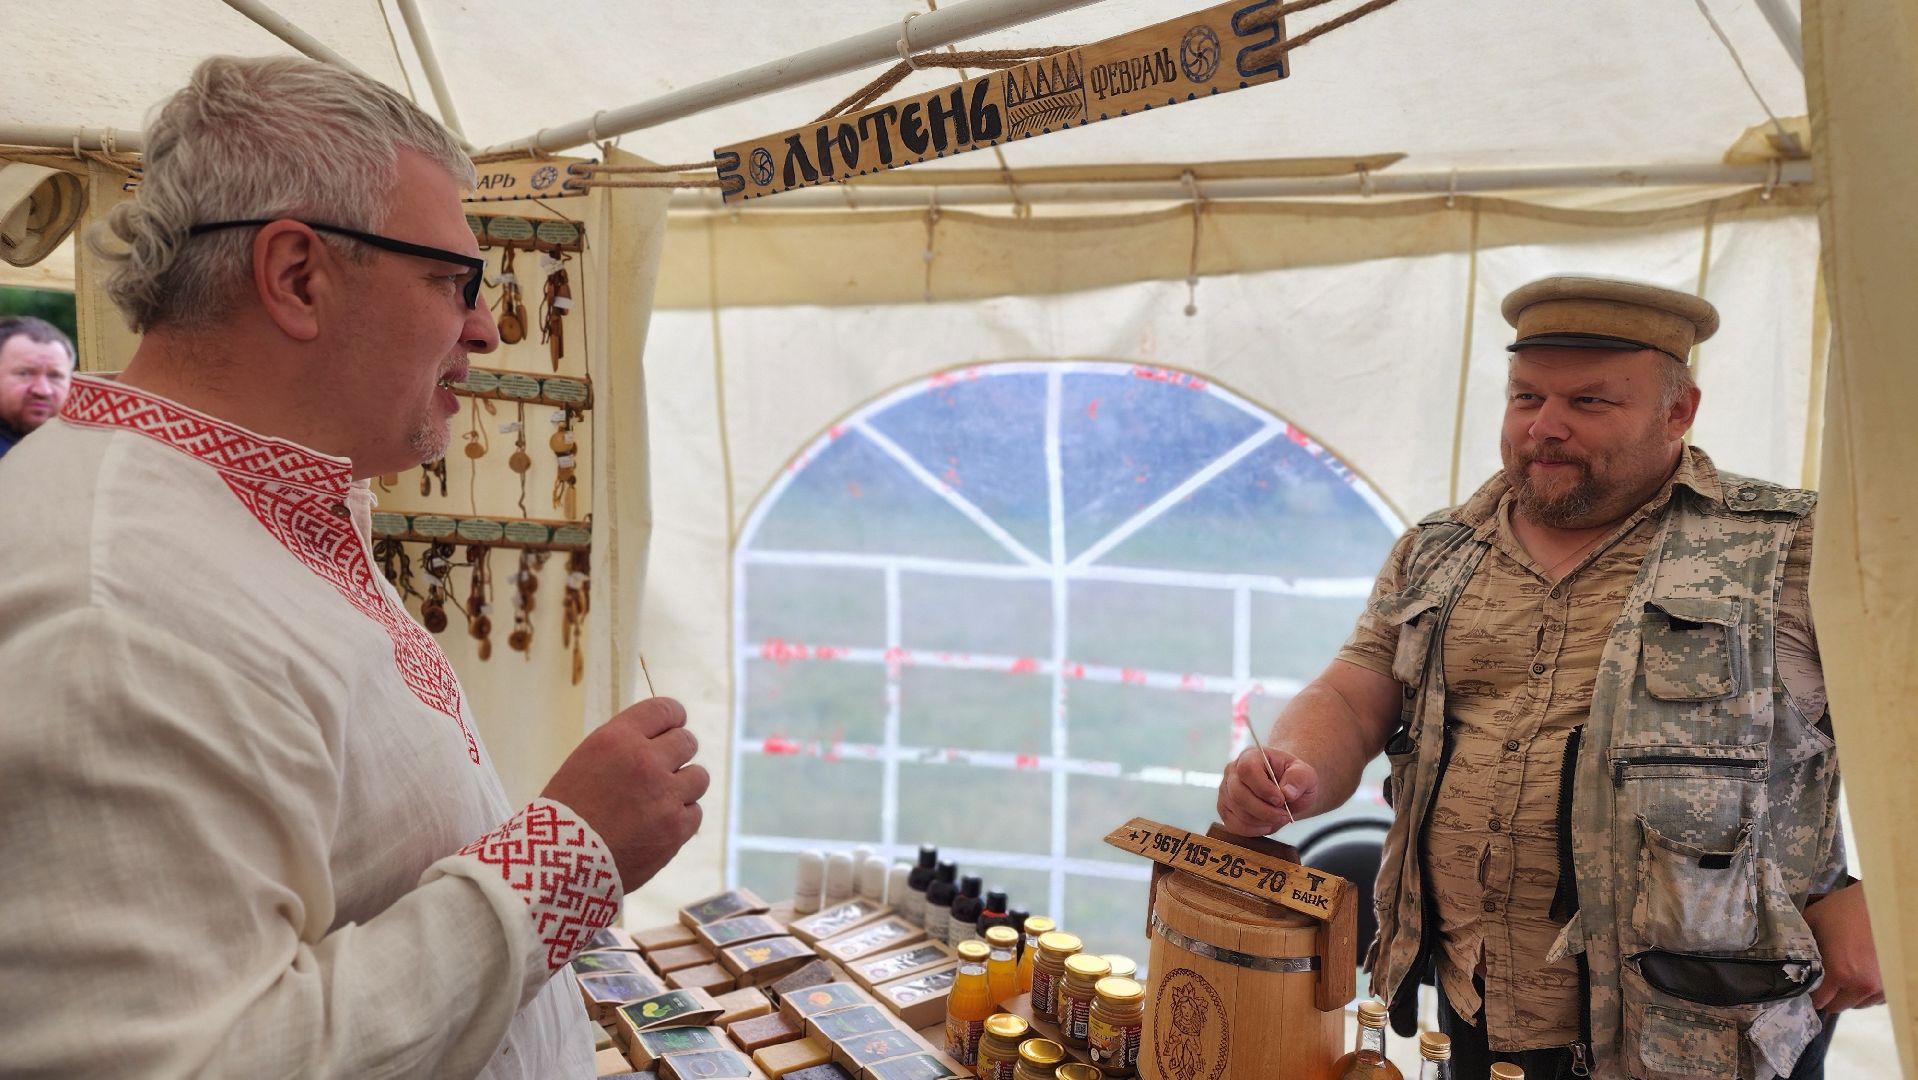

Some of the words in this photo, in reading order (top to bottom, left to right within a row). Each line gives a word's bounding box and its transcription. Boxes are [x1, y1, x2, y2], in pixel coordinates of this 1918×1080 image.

[783, 78, 1001, 187] ЛЮТЕНЬ
[1090, 47, 1177, 100] ФЕВРАЛЬ
[476, 173, 516, 190] АРЬ
[1306, 872, 1326, 892] Т
[1291, 889, 1329, 910] БАНК
